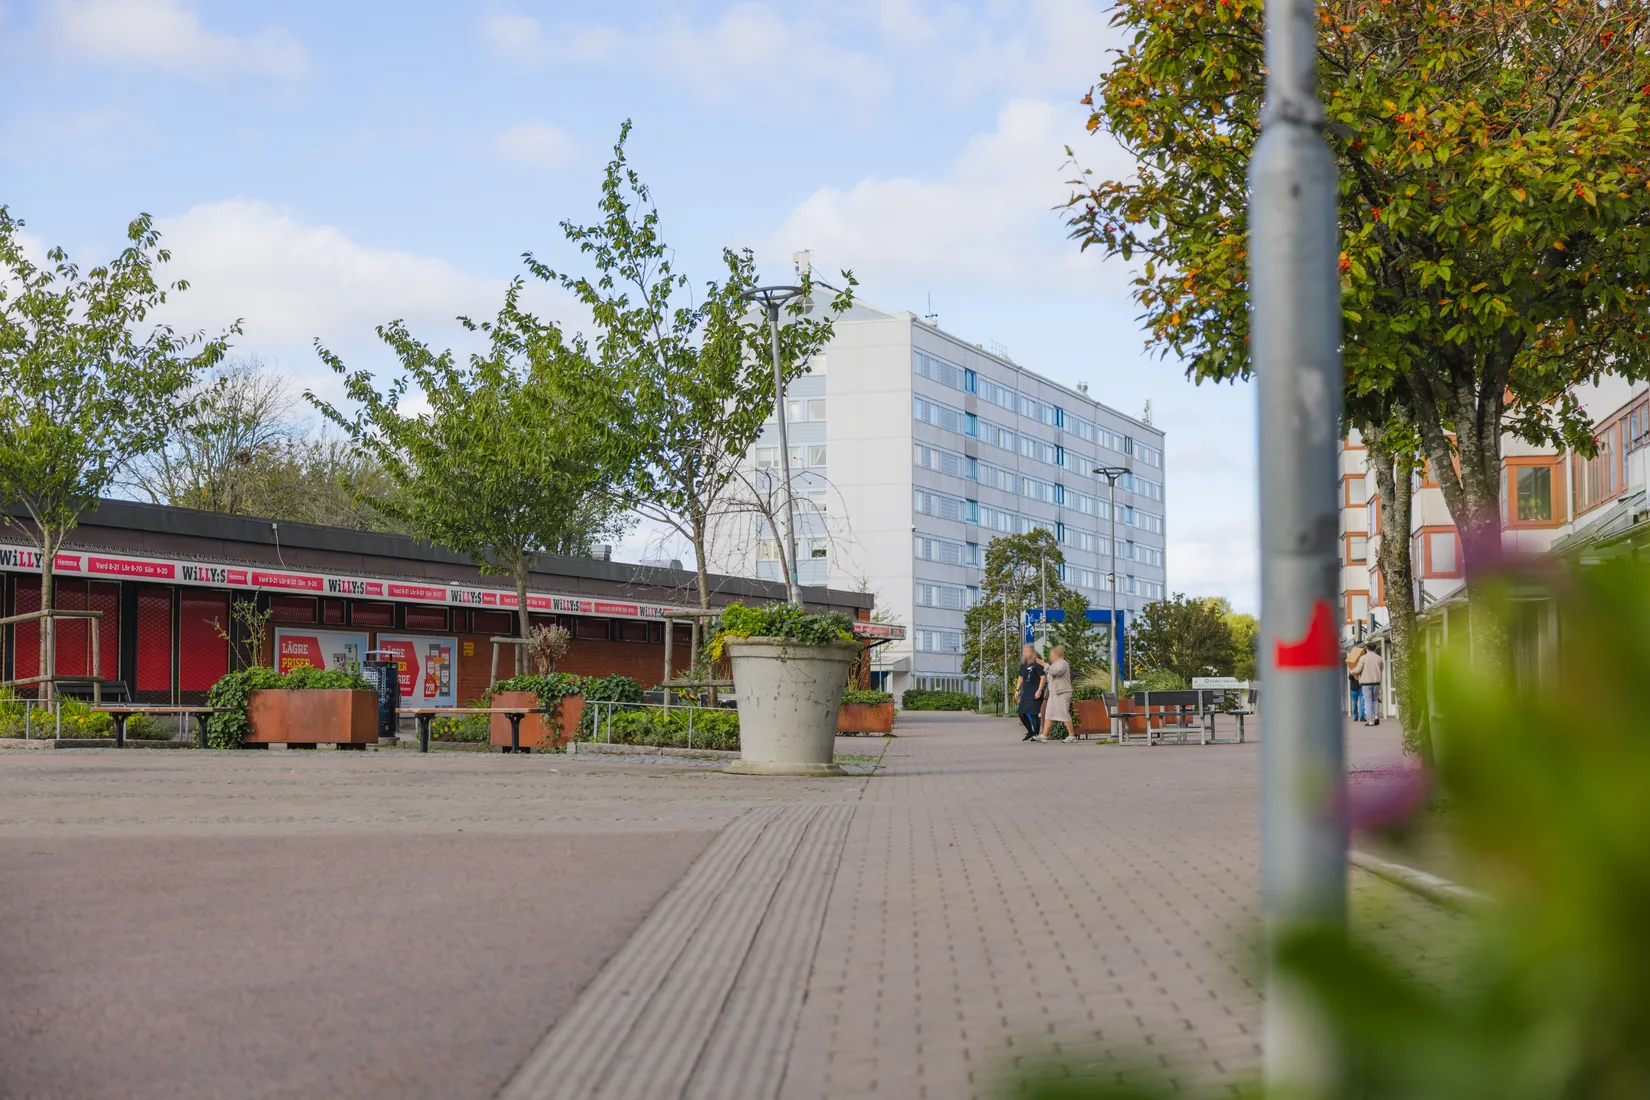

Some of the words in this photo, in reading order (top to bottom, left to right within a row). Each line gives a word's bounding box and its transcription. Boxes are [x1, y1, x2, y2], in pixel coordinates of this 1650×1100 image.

[0, 549, 42, 568] WiLLY
[57, 558, 77, 567] Hemma
[95, 562, 108, 570] Vard
[122, 564, 130, 572] Lör
[157, 567, 168, 575] 9-20
[182, 566, 226, 583] WiLLY:S
[328, 579, 365, 594] WiLLY:S
[451, 590, 482, 604] WiLLY:S
